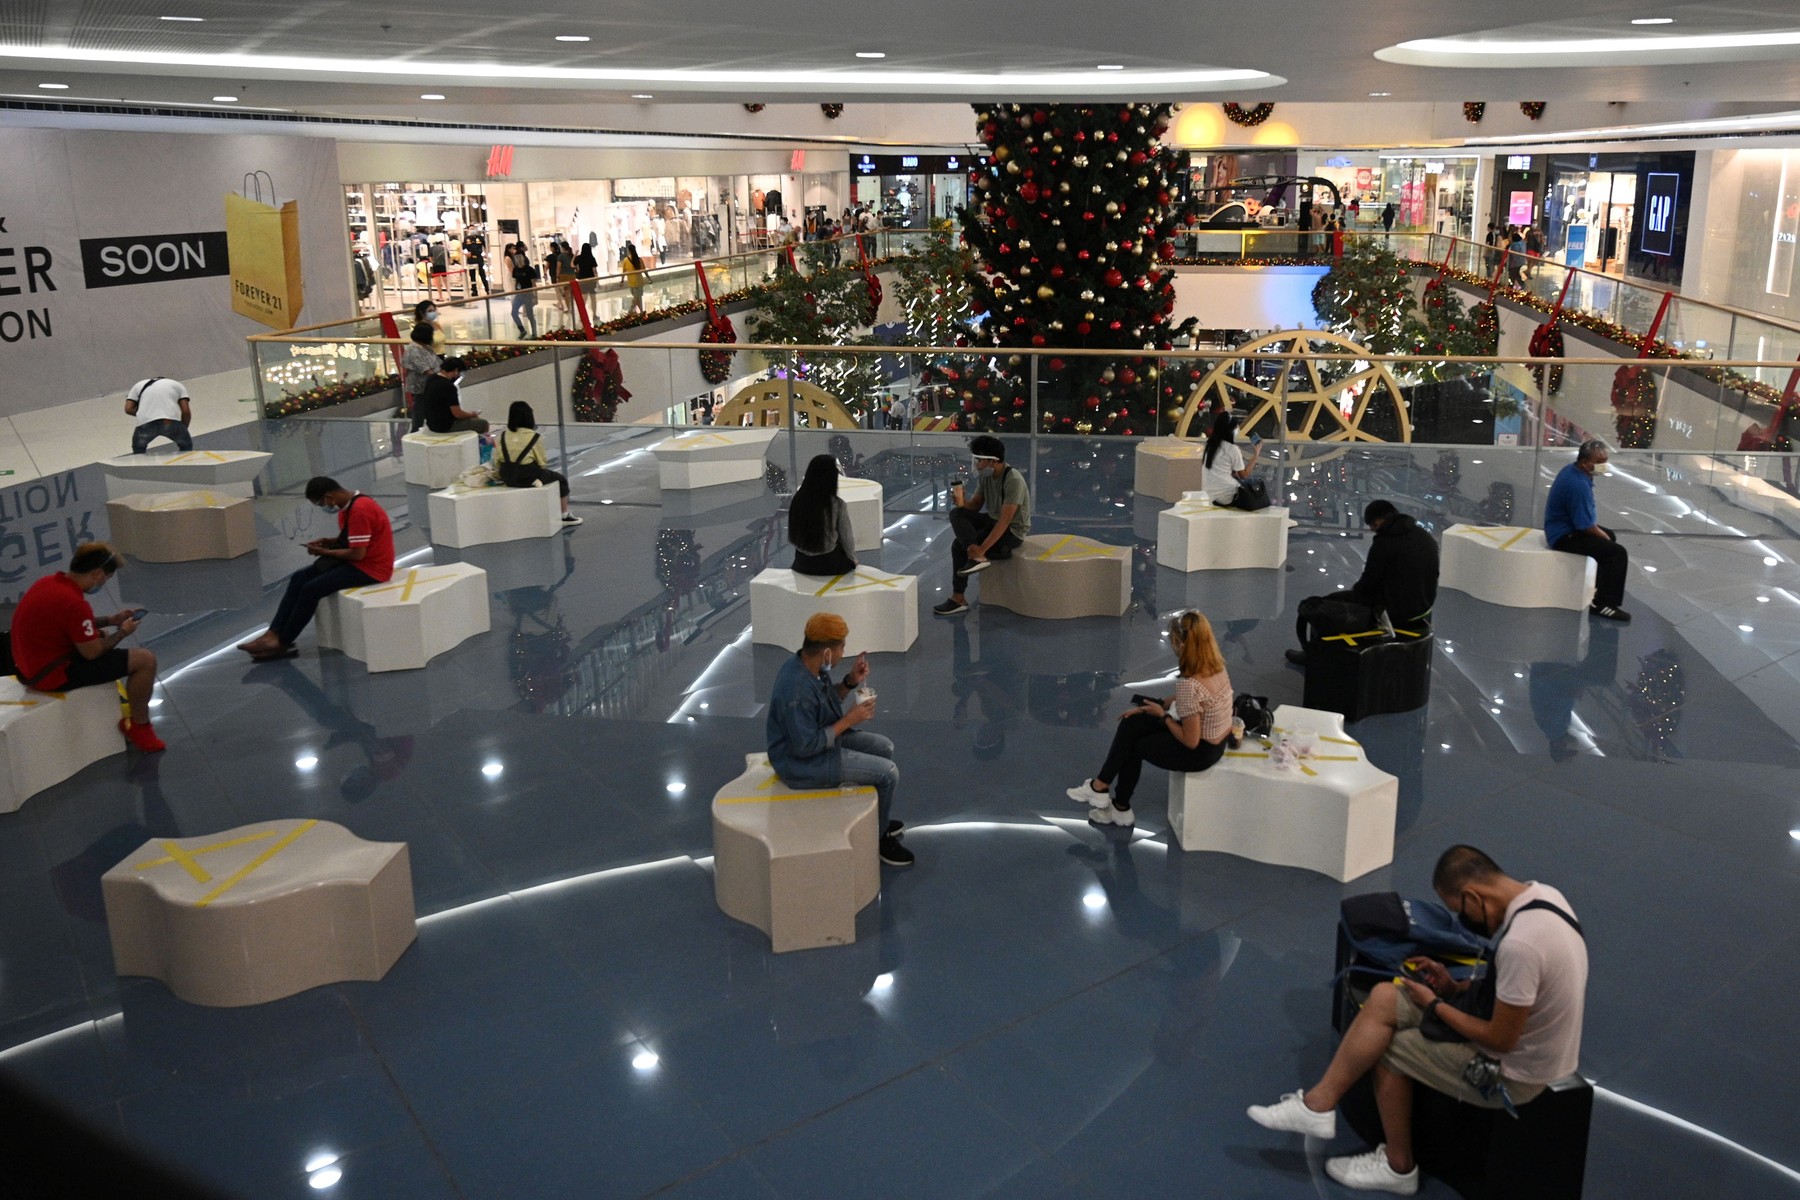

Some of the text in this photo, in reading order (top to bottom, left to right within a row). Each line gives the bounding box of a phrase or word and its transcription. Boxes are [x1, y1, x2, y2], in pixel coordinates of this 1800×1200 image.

[1648, 195, 1671, 232] GAP
[0, 246, 57, 296] ER
[100, 240, 206, 278] SOON
[235, 279, 272, 307] FOREVER
[272, 295, 282, 311] 21
[0, 308, 53, 343] ON
[82, 619, 95, 637] 3
